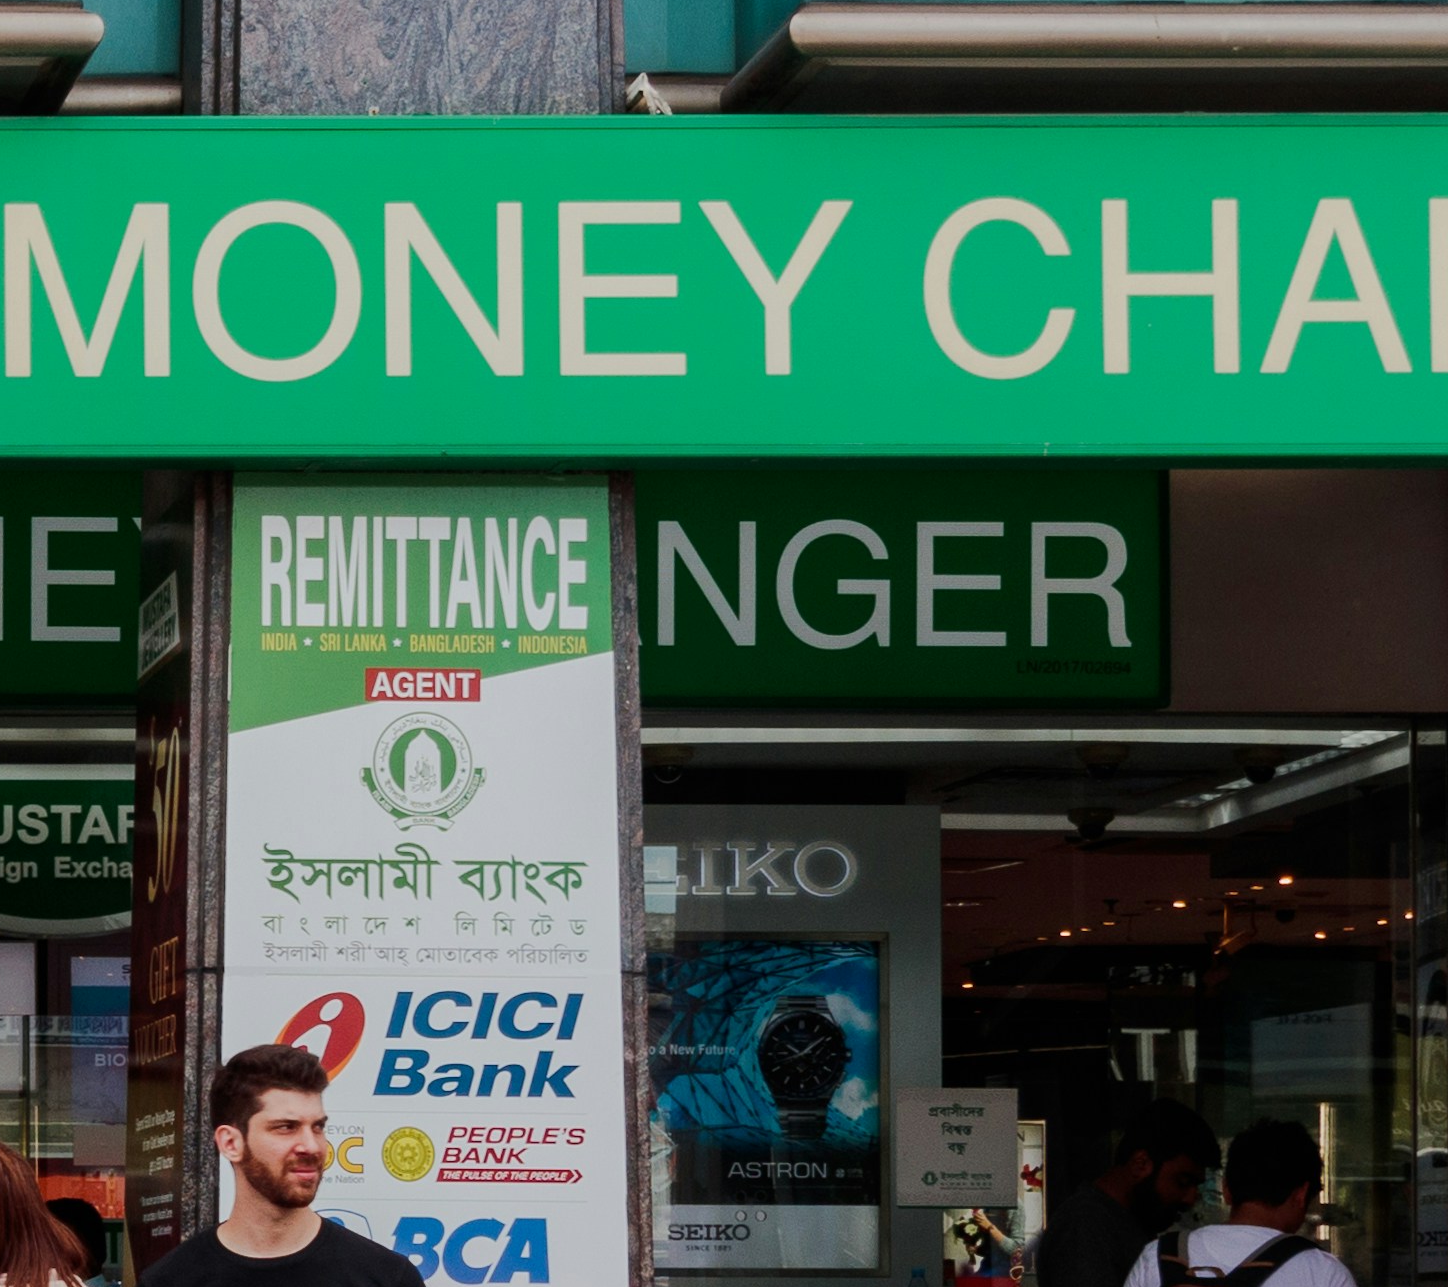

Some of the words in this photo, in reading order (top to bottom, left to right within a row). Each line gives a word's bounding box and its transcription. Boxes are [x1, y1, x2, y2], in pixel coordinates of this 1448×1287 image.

[3, 199, 854, 382] MONEY
[261, 515, 589, 631] REMITTANCE
[639, 518, 1133, 651] NGER
[261, 634, 297, 652] INDIA
[319, 634, 343, 652] SRI
[345, 634, 387, 653] LANKA
[410, 635, 495, 654] BANGLADESH
[518, 635, 588, 655] INDONESIA
[371, 671, 476, 699] AGENT
[54, 856, 133, 879] Excha
[262, 842, 441, 905] ইসলামী
[454, 854, 589, 906] ব্যাংক
[262, 940, 328, 962] ইসলামী
[415, 944, 498, 963] মোতাবেক
[506, 942, 589, 965] পরিচালিত
[149, 936, 179, 1005] GIFT
[386, 991, 584, 1041] ICICI
[659, 1046, 666, 1055] a
[669, 1044, 696, 1055] New
[697, 1044, 736, 1055] Future
[373, 1049, 579, 1099] Bank
[447, 1126, 586, 1145] PEOPLE'S
[441, 1147, 528, 1164] BANK
[334, 1175, 365, 1184] Nation
[442, 1171, 462, 1180] THE
[463, 1171, 493, 1180] PULSE
[494, 1171, 507, 1180] OF
[508, 1172, 527, 1181] THE
[528, 1172, 568, 1181] PEOPLE
[728, 1161, 828, 1179] ASTRON
[668, 1224, 751, 1242] SEIKO
[392, 1217, 550, 1285] BCA
